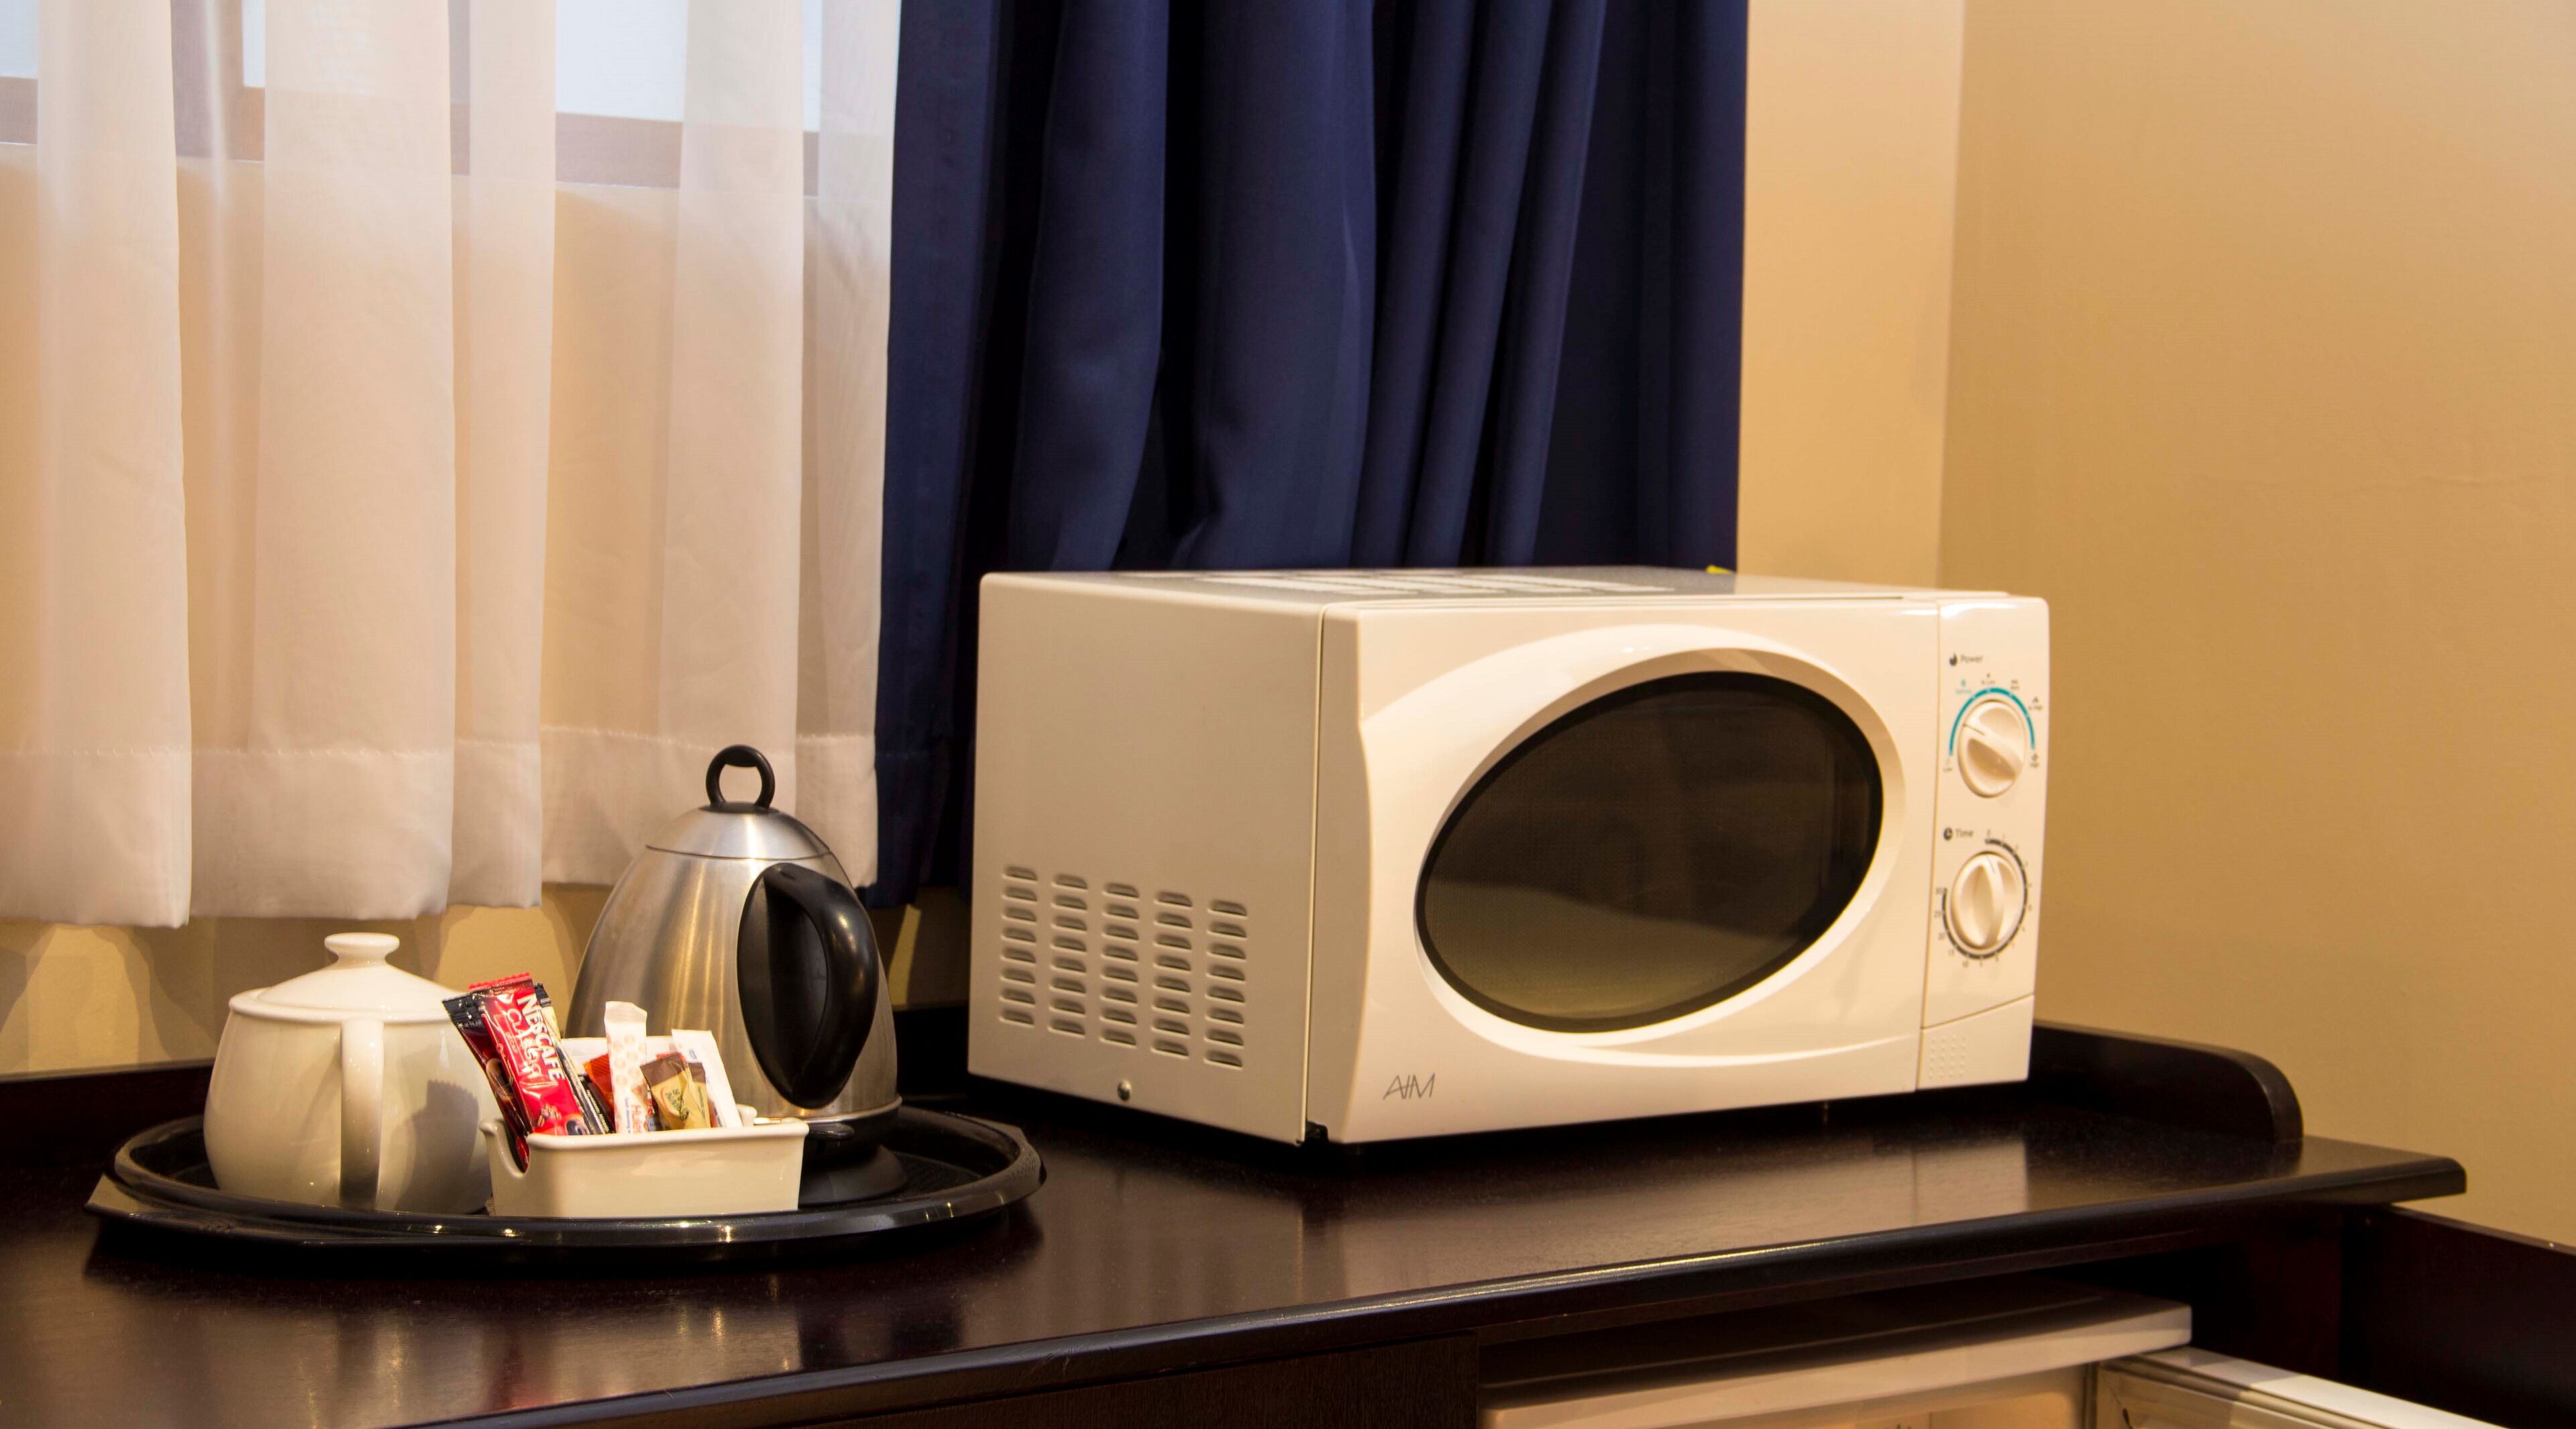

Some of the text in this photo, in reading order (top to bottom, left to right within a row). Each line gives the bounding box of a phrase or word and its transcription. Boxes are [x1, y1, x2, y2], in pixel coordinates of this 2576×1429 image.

[1960, 653, 1984, 664] Power
[1955, 829, 1974, 838] Time
[1382, 1072, 1436, 1100] AIM
